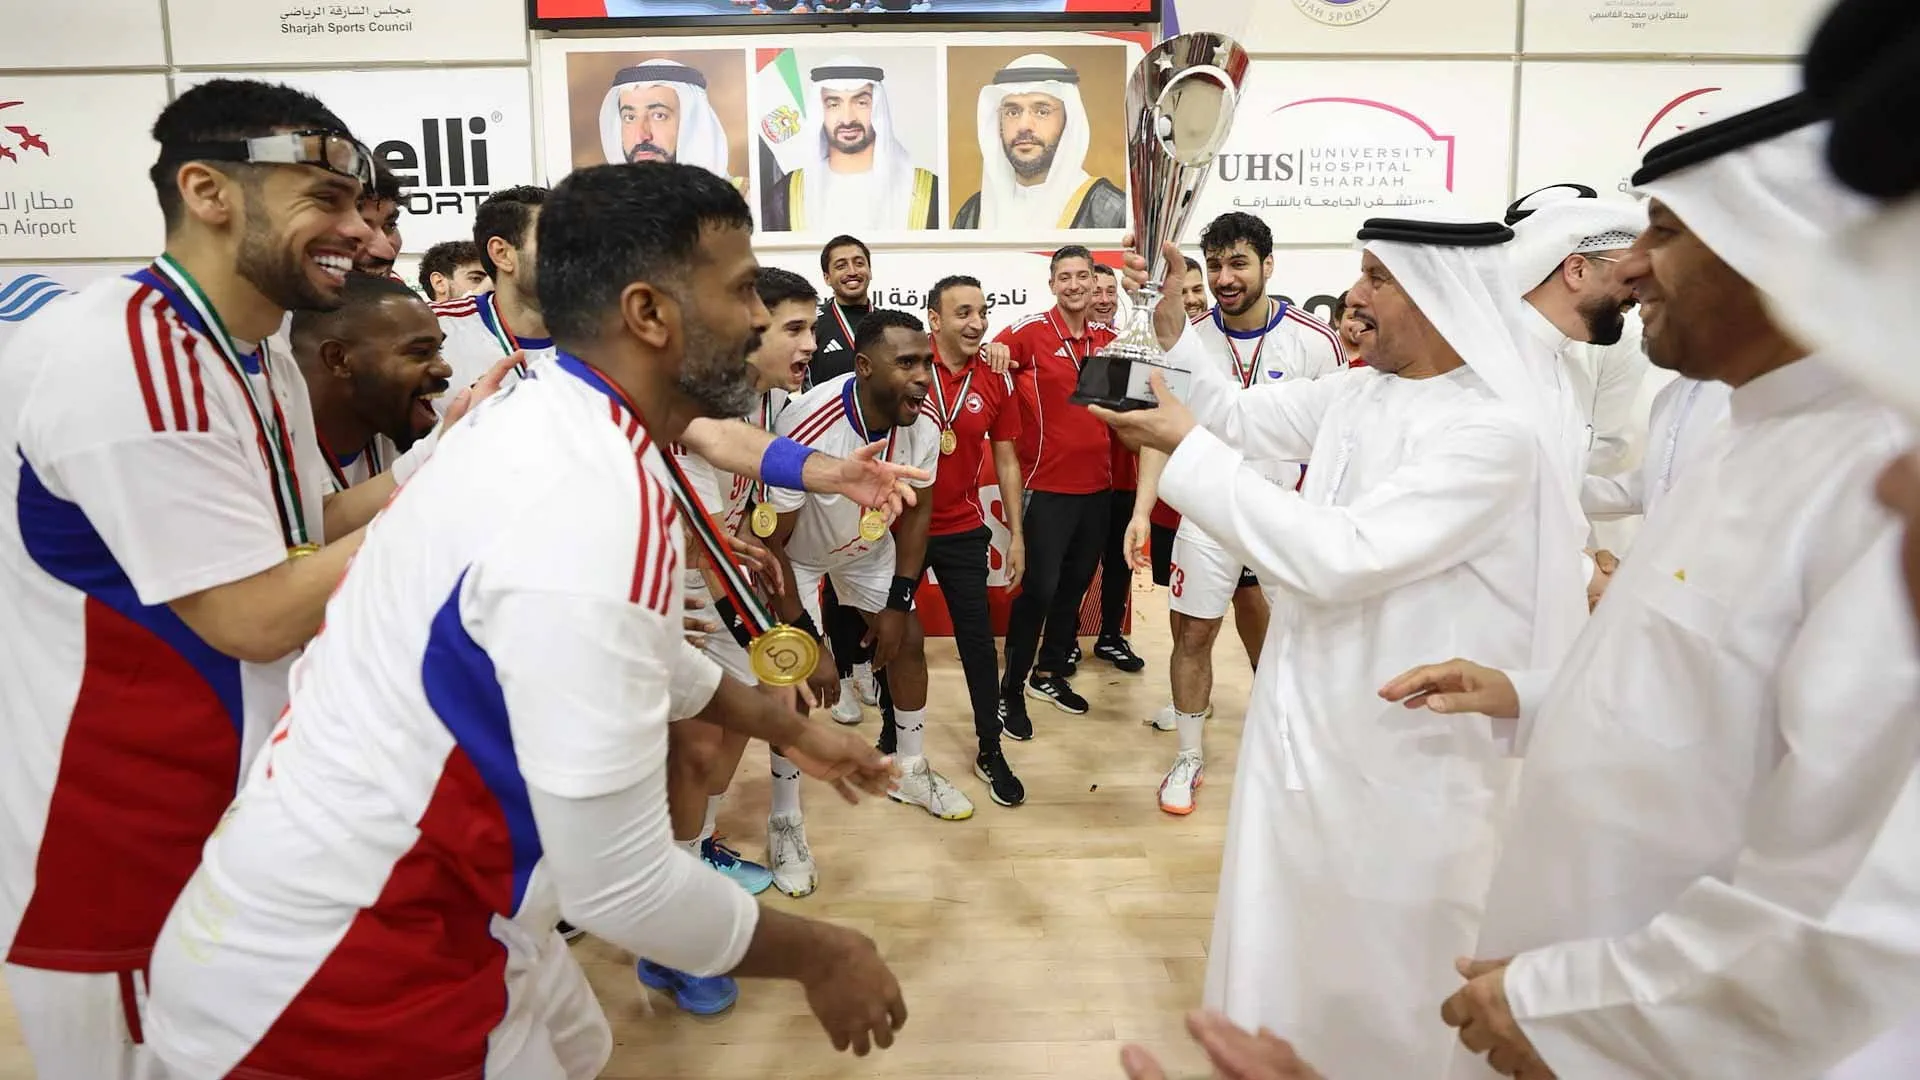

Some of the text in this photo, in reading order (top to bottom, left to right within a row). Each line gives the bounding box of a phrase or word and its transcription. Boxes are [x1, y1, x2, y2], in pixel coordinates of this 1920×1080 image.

[279, 4, 411, 19] مجلس الشارقة الرياضي
[1328, 2, 1376, 21] SPORTS
[281, 21, 413, 35] Sharjah Sports Council
[373, 116, 489, 187] elli
[1310, 148, 1437, 158] UNIVERSITY
[1218, 153, 1294, 182] UHS
[1310, 162, 1411, 172] HOSPITAL
[1310, 176, 1404, 187] SHARJAH
[24, 191, 74, 214] مطار
[406, 191, 490, 215] ORT
[1233, 197, 1301, 209] بالشارقة
[1304, 197, 1361, 208] الجامعة
[14, 218, 77, 237] Airport
